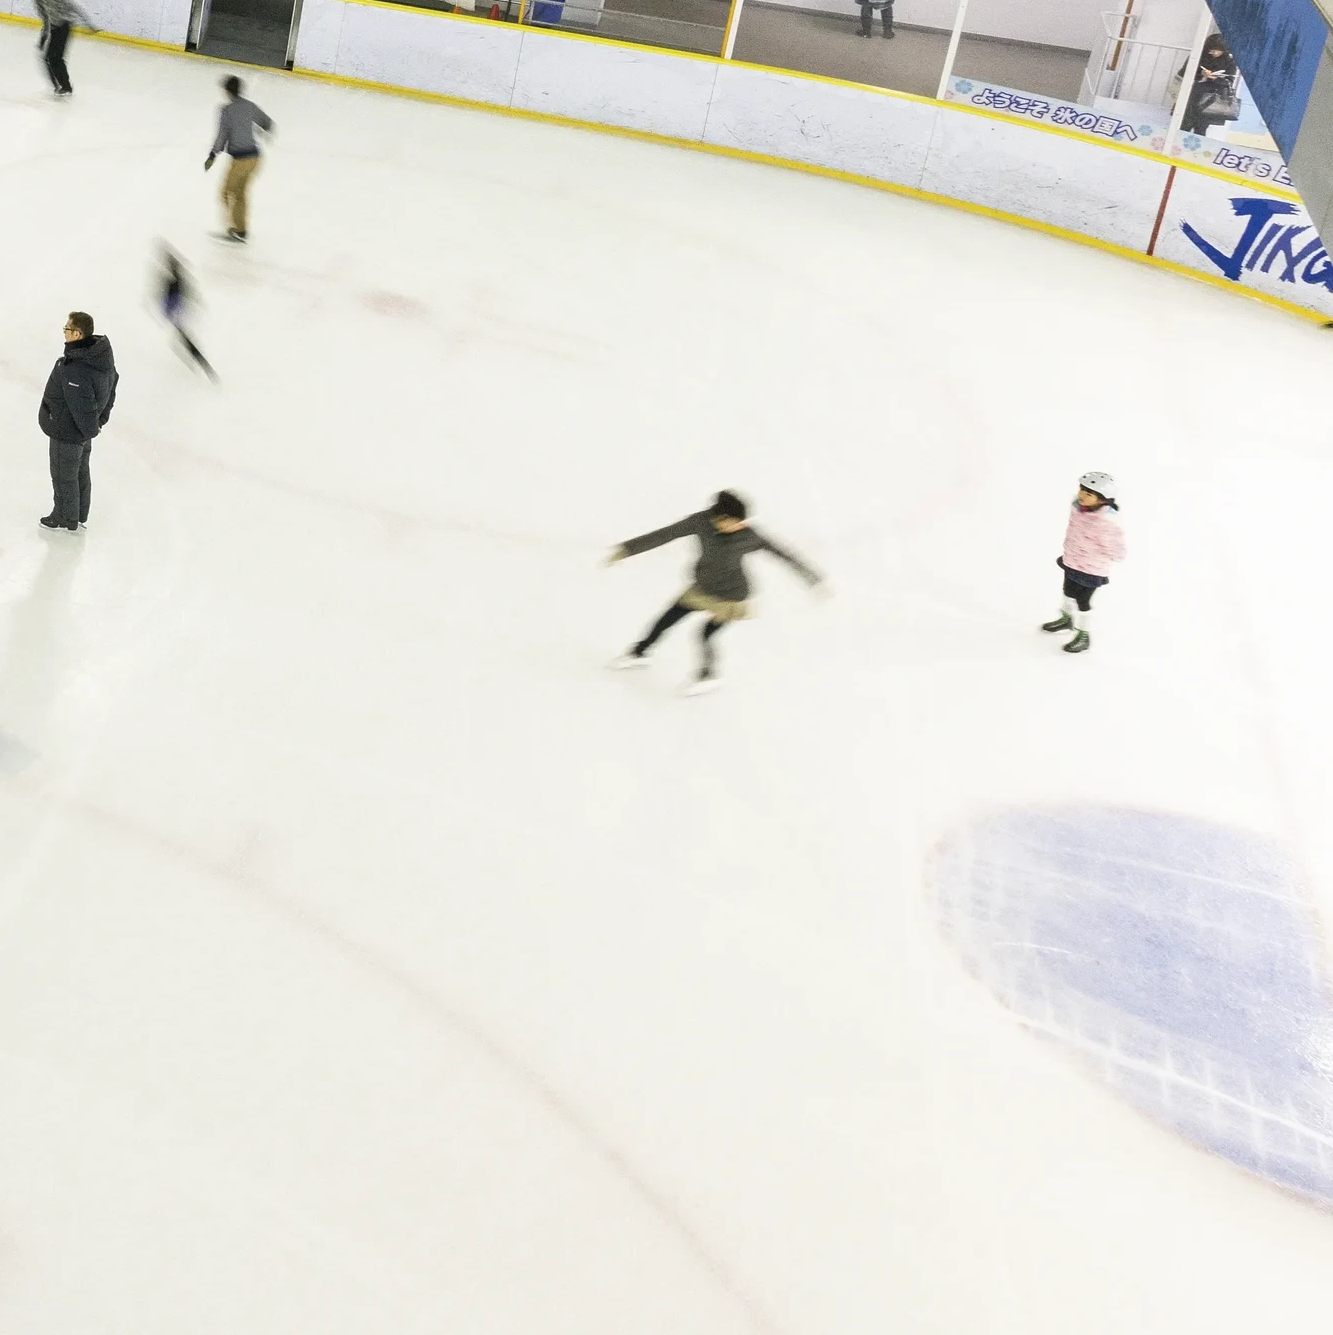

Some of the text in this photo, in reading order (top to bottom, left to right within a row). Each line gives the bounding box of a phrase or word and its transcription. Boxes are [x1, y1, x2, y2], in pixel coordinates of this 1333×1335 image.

[971, 88, 1137, 142] ようこそ 氷の国へ
[1213, 148, 1271, 178] let's
